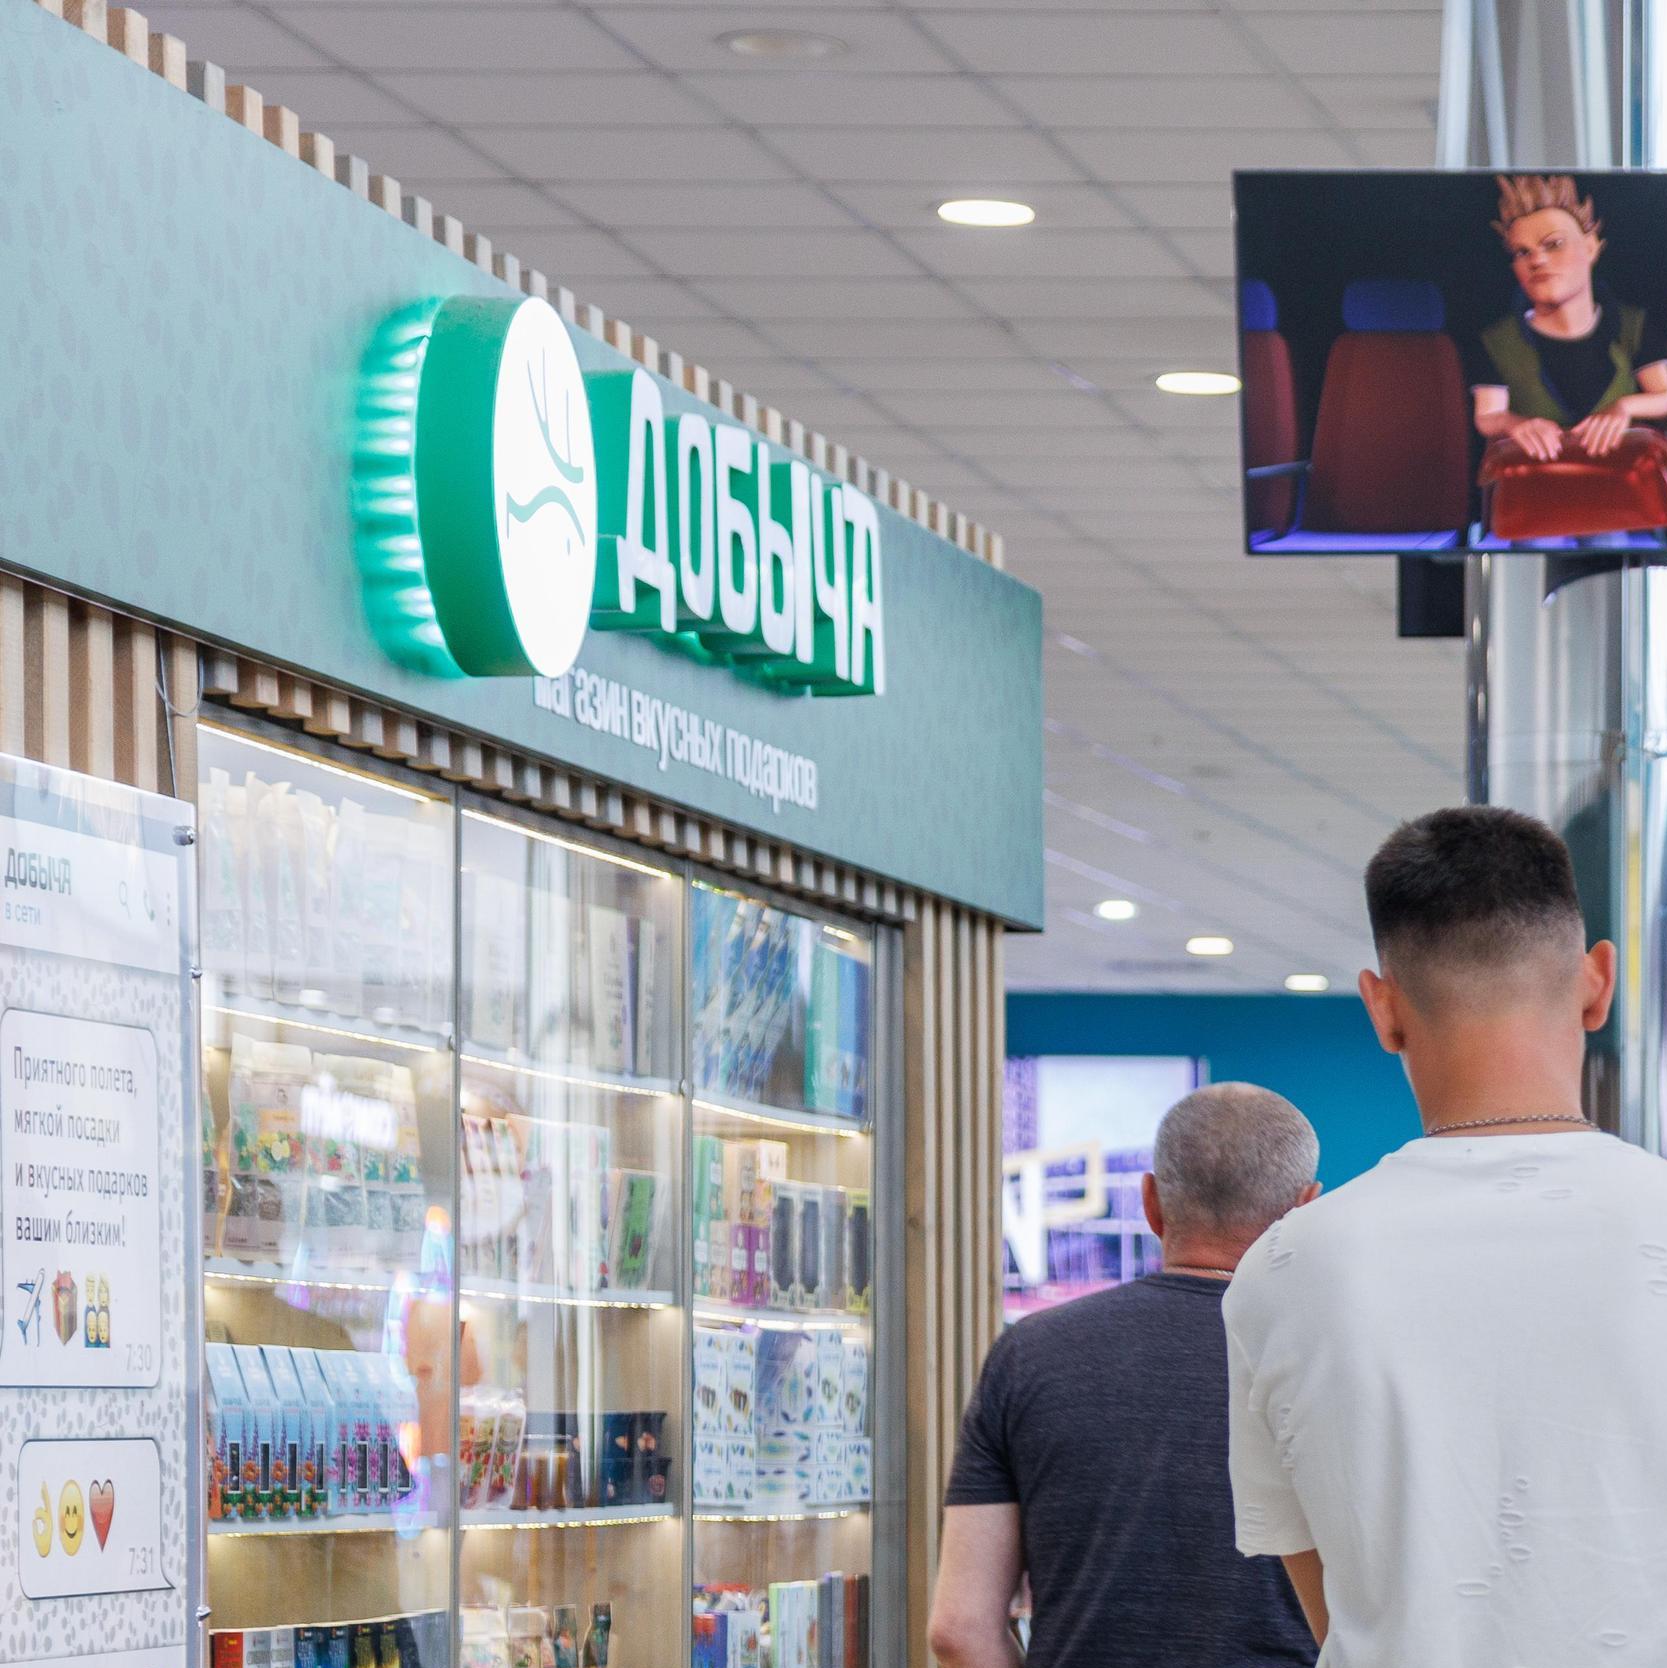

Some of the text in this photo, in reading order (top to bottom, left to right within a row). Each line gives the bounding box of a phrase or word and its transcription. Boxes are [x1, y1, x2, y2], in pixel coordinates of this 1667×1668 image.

[617, 368, 885, 696] ДОБЫЧА
[632, 687, 722, 772] вкусных
[726, 730, 817, 814] подарков
[5, 847, 72, 895] ДОБЫЧА
[15, 904, 41, 925] сети
[14, 1046, 138, 1098] Приятного полета,
[14, 1104, 120, 1147] мягкой посадки
[15, 1163, 148, 1203] и вкусных подарков
[16, 1210, 126, 1248] вашим близким!
[126, 1343, 152, 1371] 7:30
[129, 1546, 154, 1575] 7:31
